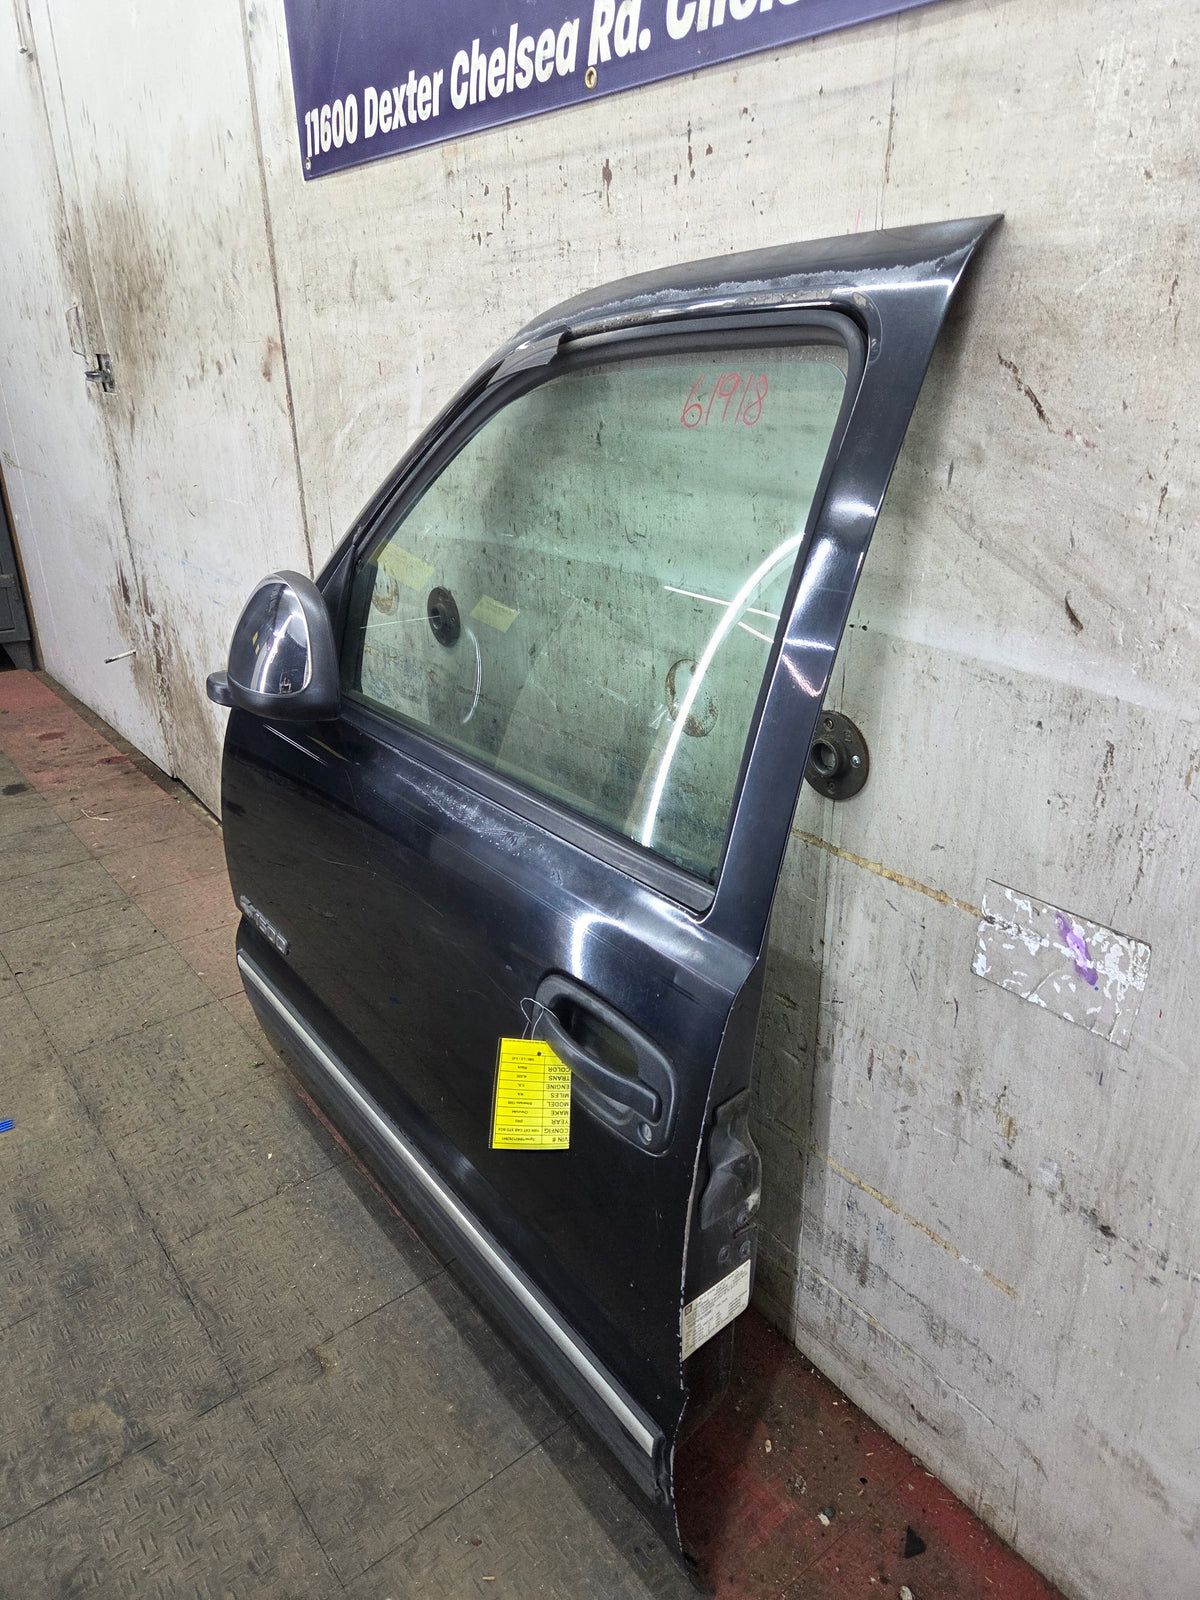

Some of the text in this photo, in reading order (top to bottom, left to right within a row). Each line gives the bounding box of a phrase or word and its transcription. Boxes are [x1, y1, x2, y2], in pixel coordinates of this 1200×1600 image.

[304, 93, 358, 158] 11600
[364, 68, 444, 139] Dexter
[450, 18, 580, 110] Chelsea
[587, 0, 651, 67] Rd.
[681, 372, 769, 428] 61918
